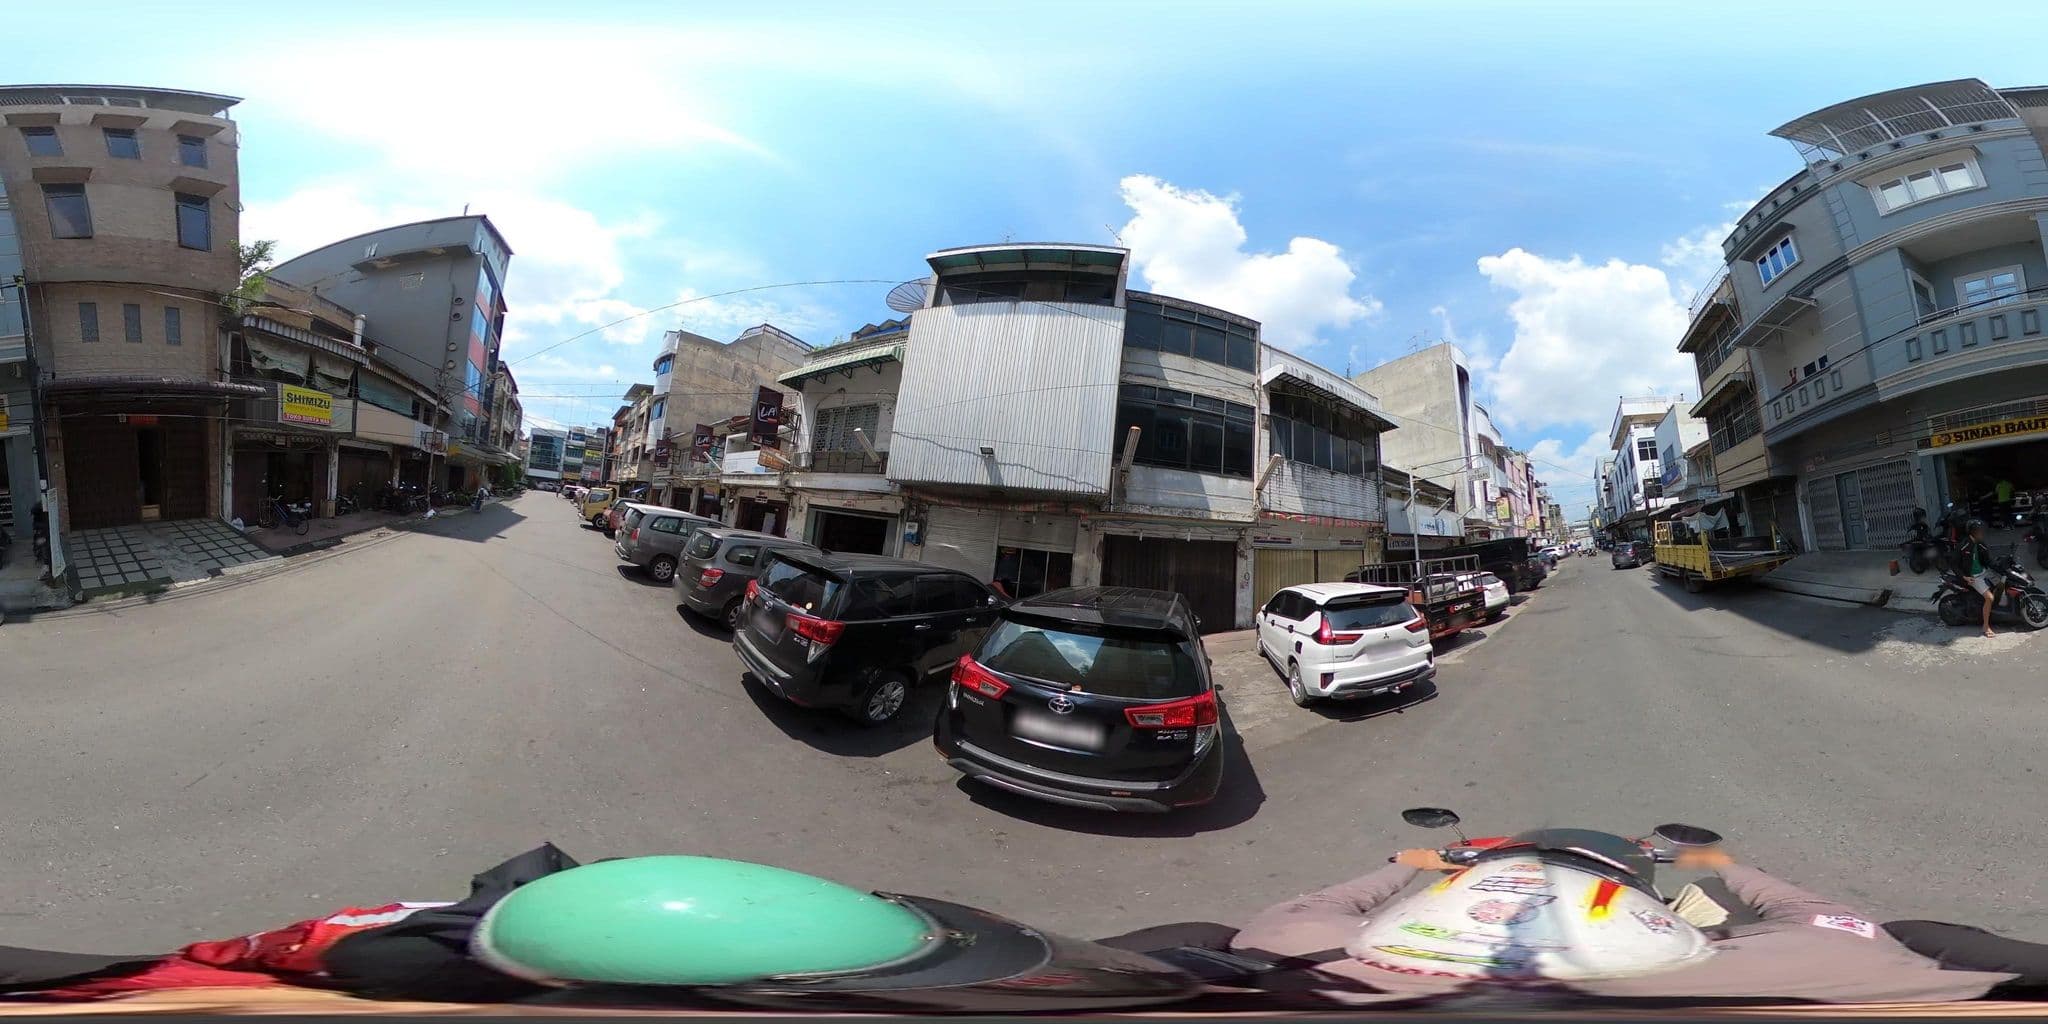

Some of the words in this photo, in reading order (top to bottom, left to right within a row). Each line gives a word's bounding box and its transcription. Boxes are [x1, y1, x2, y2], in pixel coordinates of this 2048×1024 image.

[286, 392, 330, 409] SHIMIZU
[761, 406, 776, 417] LA
[1954, 424, 2001, 442] SINAR
[2005, 418, 2048, 433] BAUT
